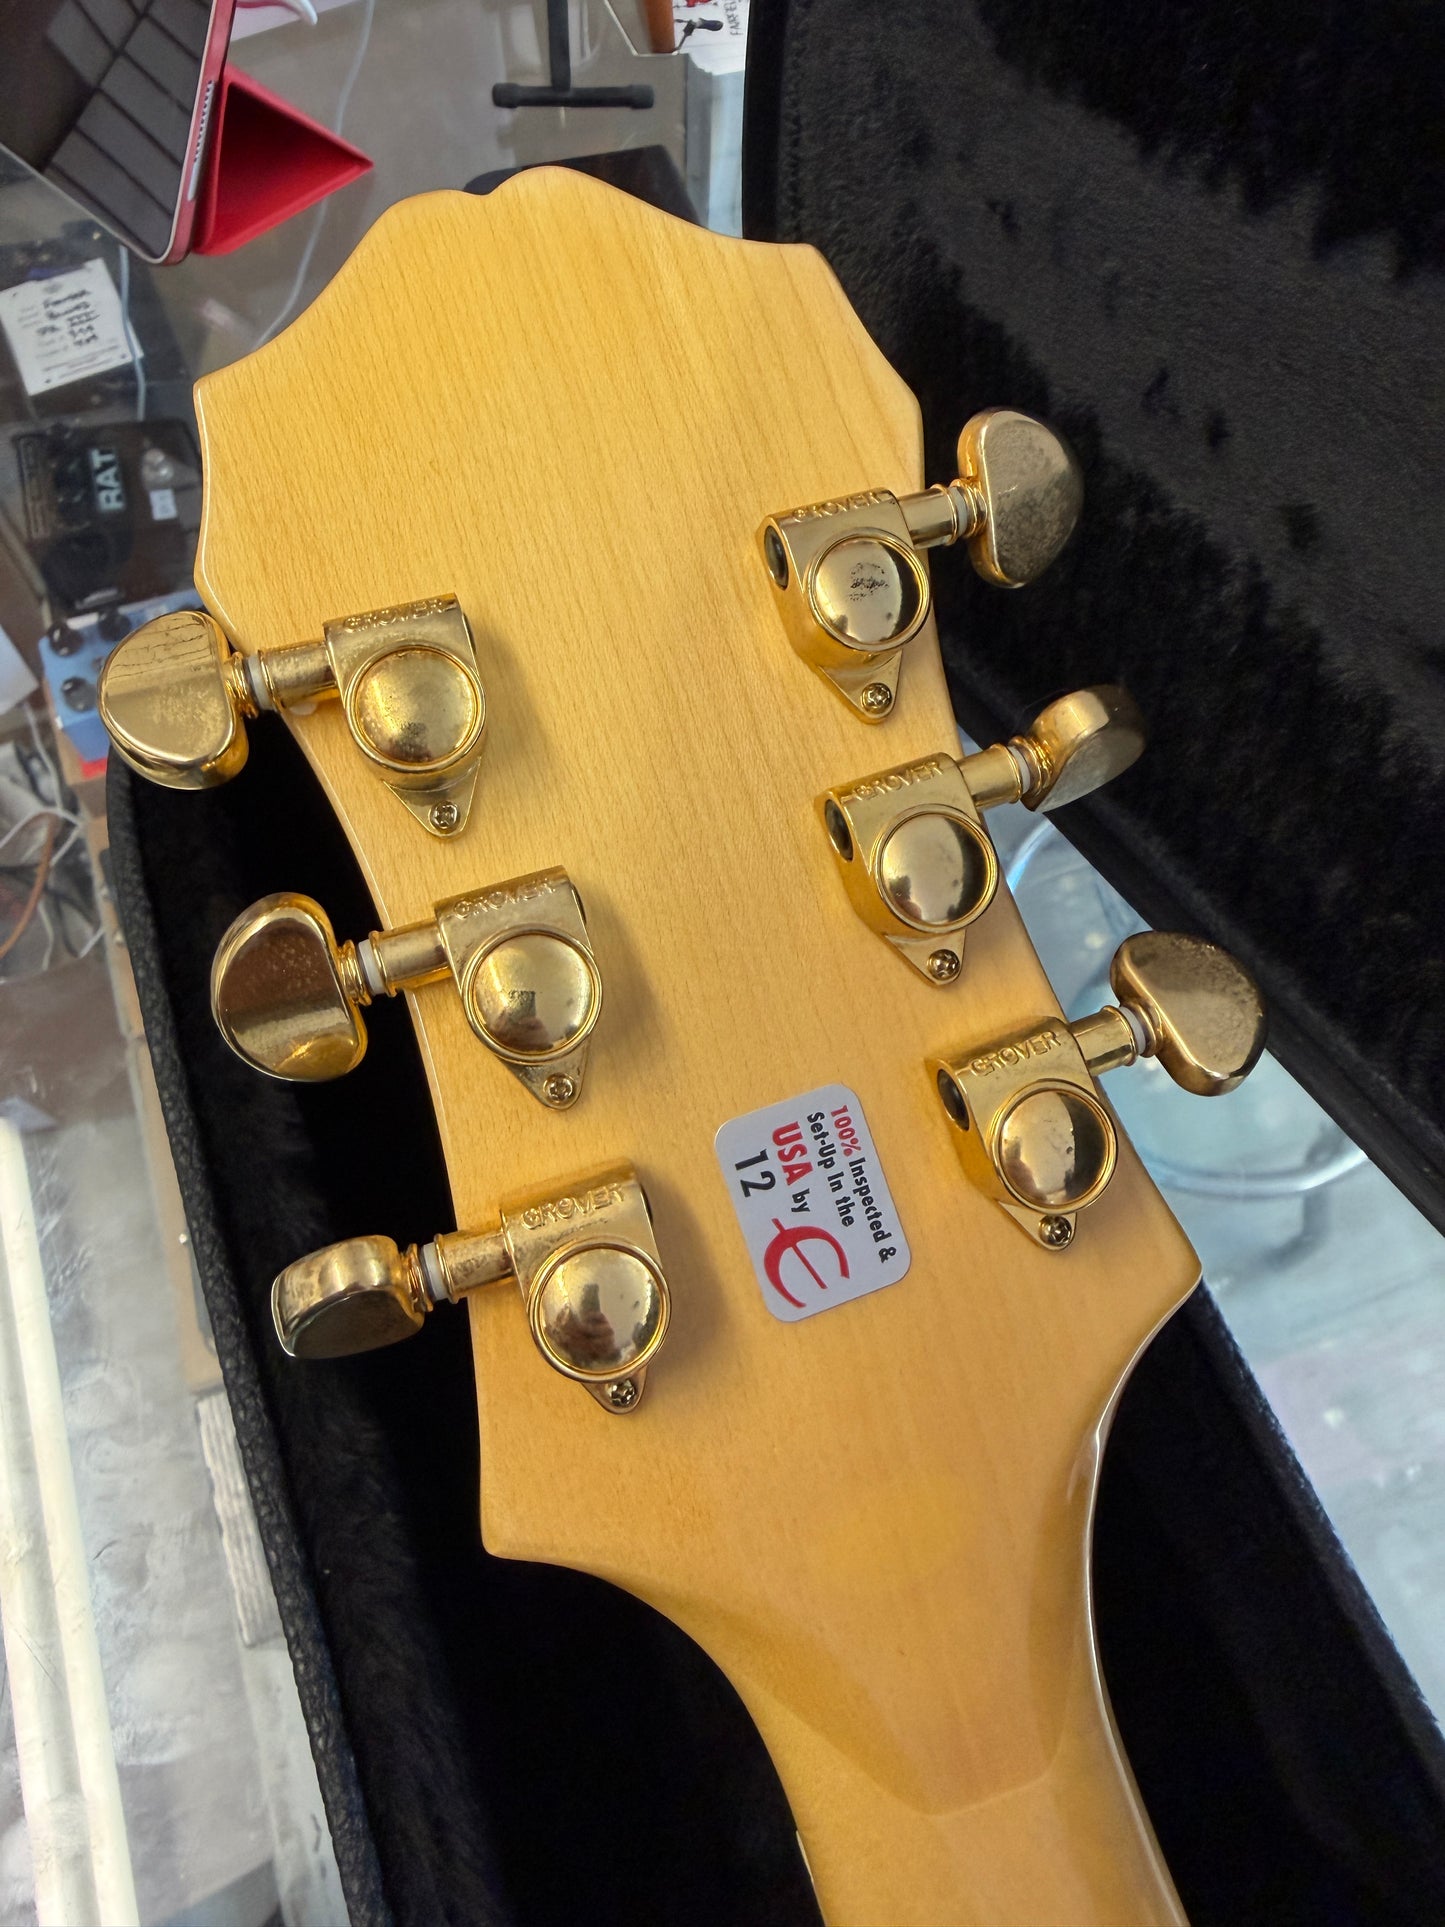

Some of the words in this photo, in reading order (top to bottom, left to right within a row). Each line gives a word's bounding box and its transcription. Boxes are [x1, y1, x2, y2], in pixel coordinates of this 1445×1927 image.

[91, 449, 124, 511] RAT
[852, 761, 944, 801] GROVER
[968, 1031, 1062, 1077] GROVER
[771, 1121, 814, 1187] USA
[806, 1111, 837, 1170] Set-Up
[735, 1148, 776, 1198] 12
[827, 1171, 845, 1193] In
[830, 1104, 862, 1158] 100%
[848, 1156, 893, 1243] Inspected
[878, 1246, 897, 1264] &
[520, 1182, 625, 1230] GROVER
[791, 1188, 811, 1213] by
[835, 1196, 855, 1228] the
